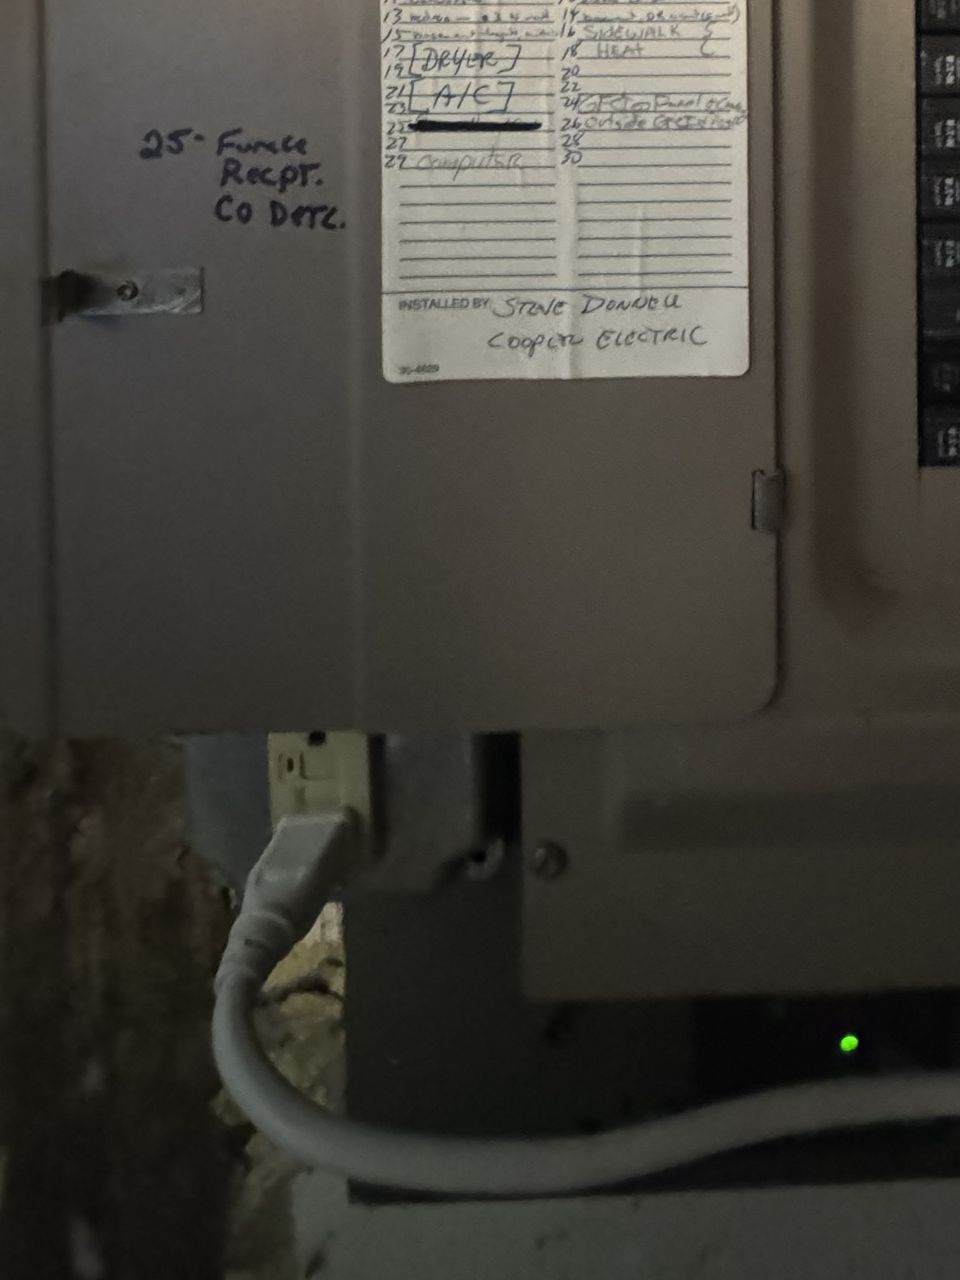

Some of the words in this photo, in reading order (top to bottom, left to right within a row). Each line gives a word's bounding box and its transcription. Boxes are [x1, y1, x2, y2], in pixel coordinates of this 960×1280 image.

[384, 7, 403, 25] 13
[563, 7, 578, 23] 14
[560, 24, 576, 38] 16
[384, 41, 403, 58] 17
[562, 42, 581, 61] 18
[561, 65, 580, 82] 20
[561, 81, 581, 94] 22
[562, 94, 581, 111] 24
[561, 118, 581, 132] 26
[386, 136, 407, 151] 27
[561, 132, 585, 148] 28
[561, 150, 583, 165] 30
[399, 297, 469, 311] INSTALLED
[471, 297, 489, 309] BY
[596, 325, 710, 351] ELECTRIC
